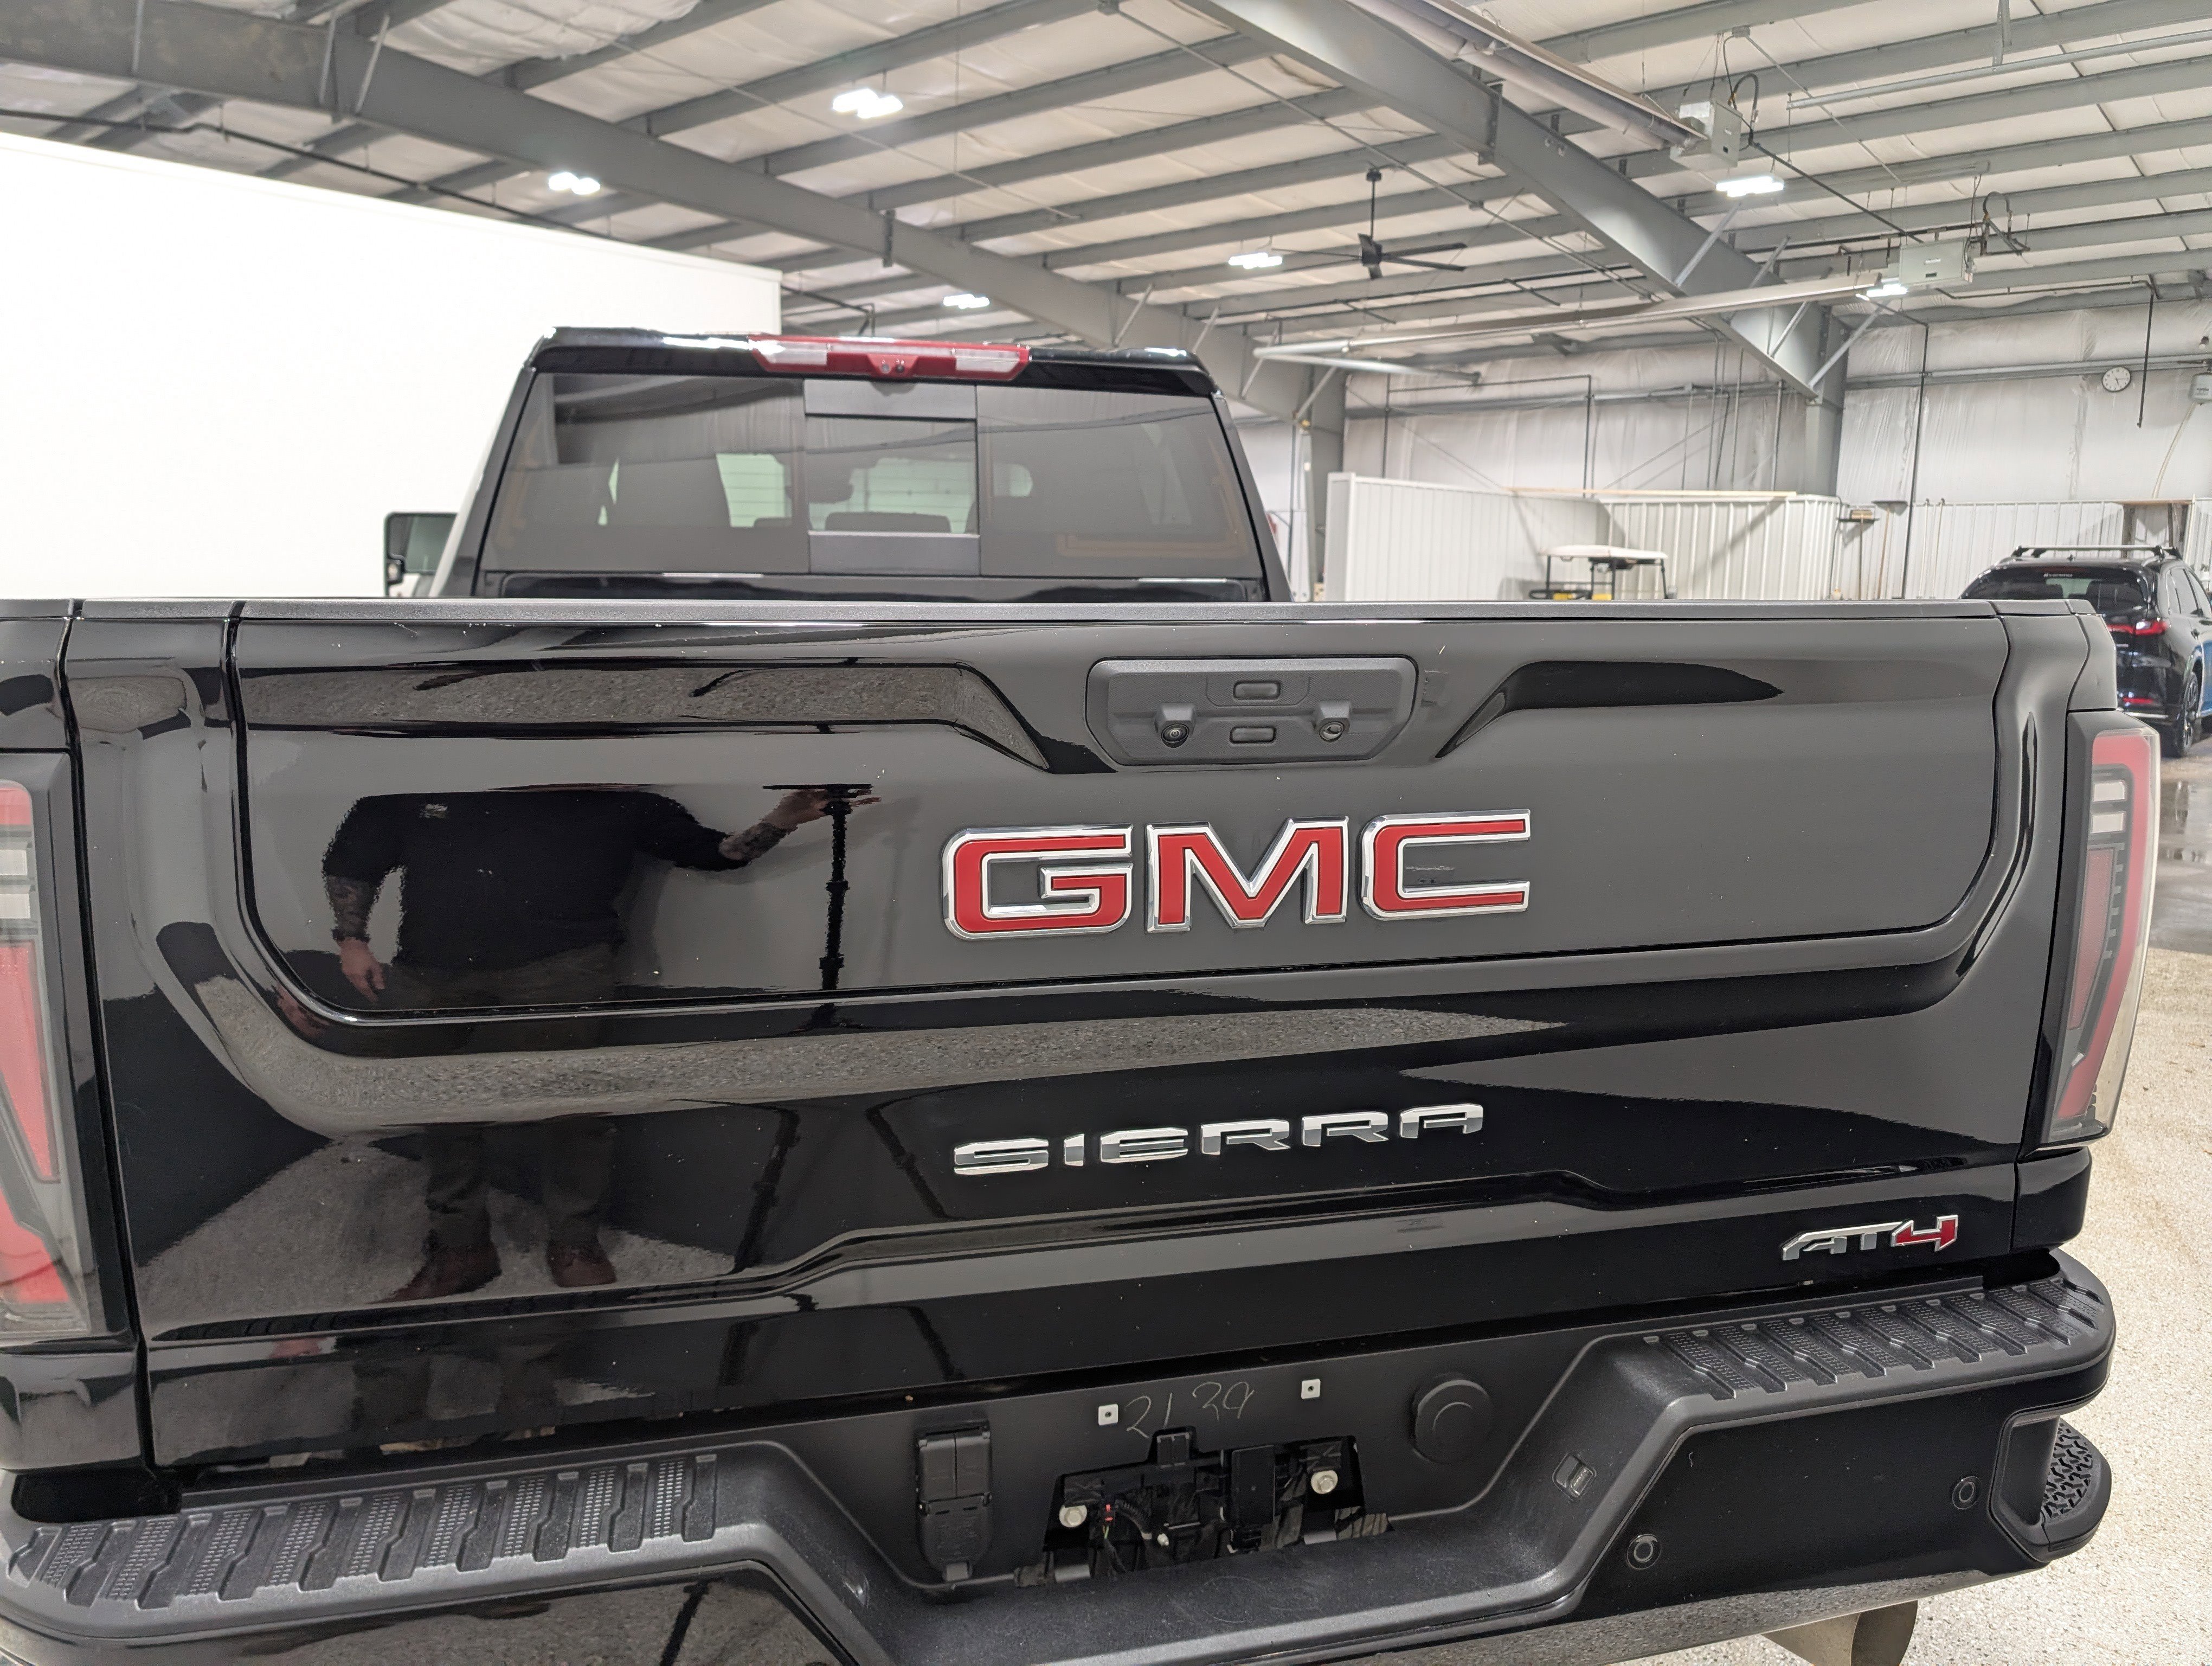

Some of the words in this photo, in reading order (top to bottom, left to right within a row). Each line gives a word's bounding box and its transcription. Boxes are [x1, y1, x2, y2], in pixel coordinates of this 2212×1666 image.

[942, 808, 1531, 940] GMC
[953, 1103, 1484, 1176] SIERRA
[1782, 1214, 1958, 1261] AT4
